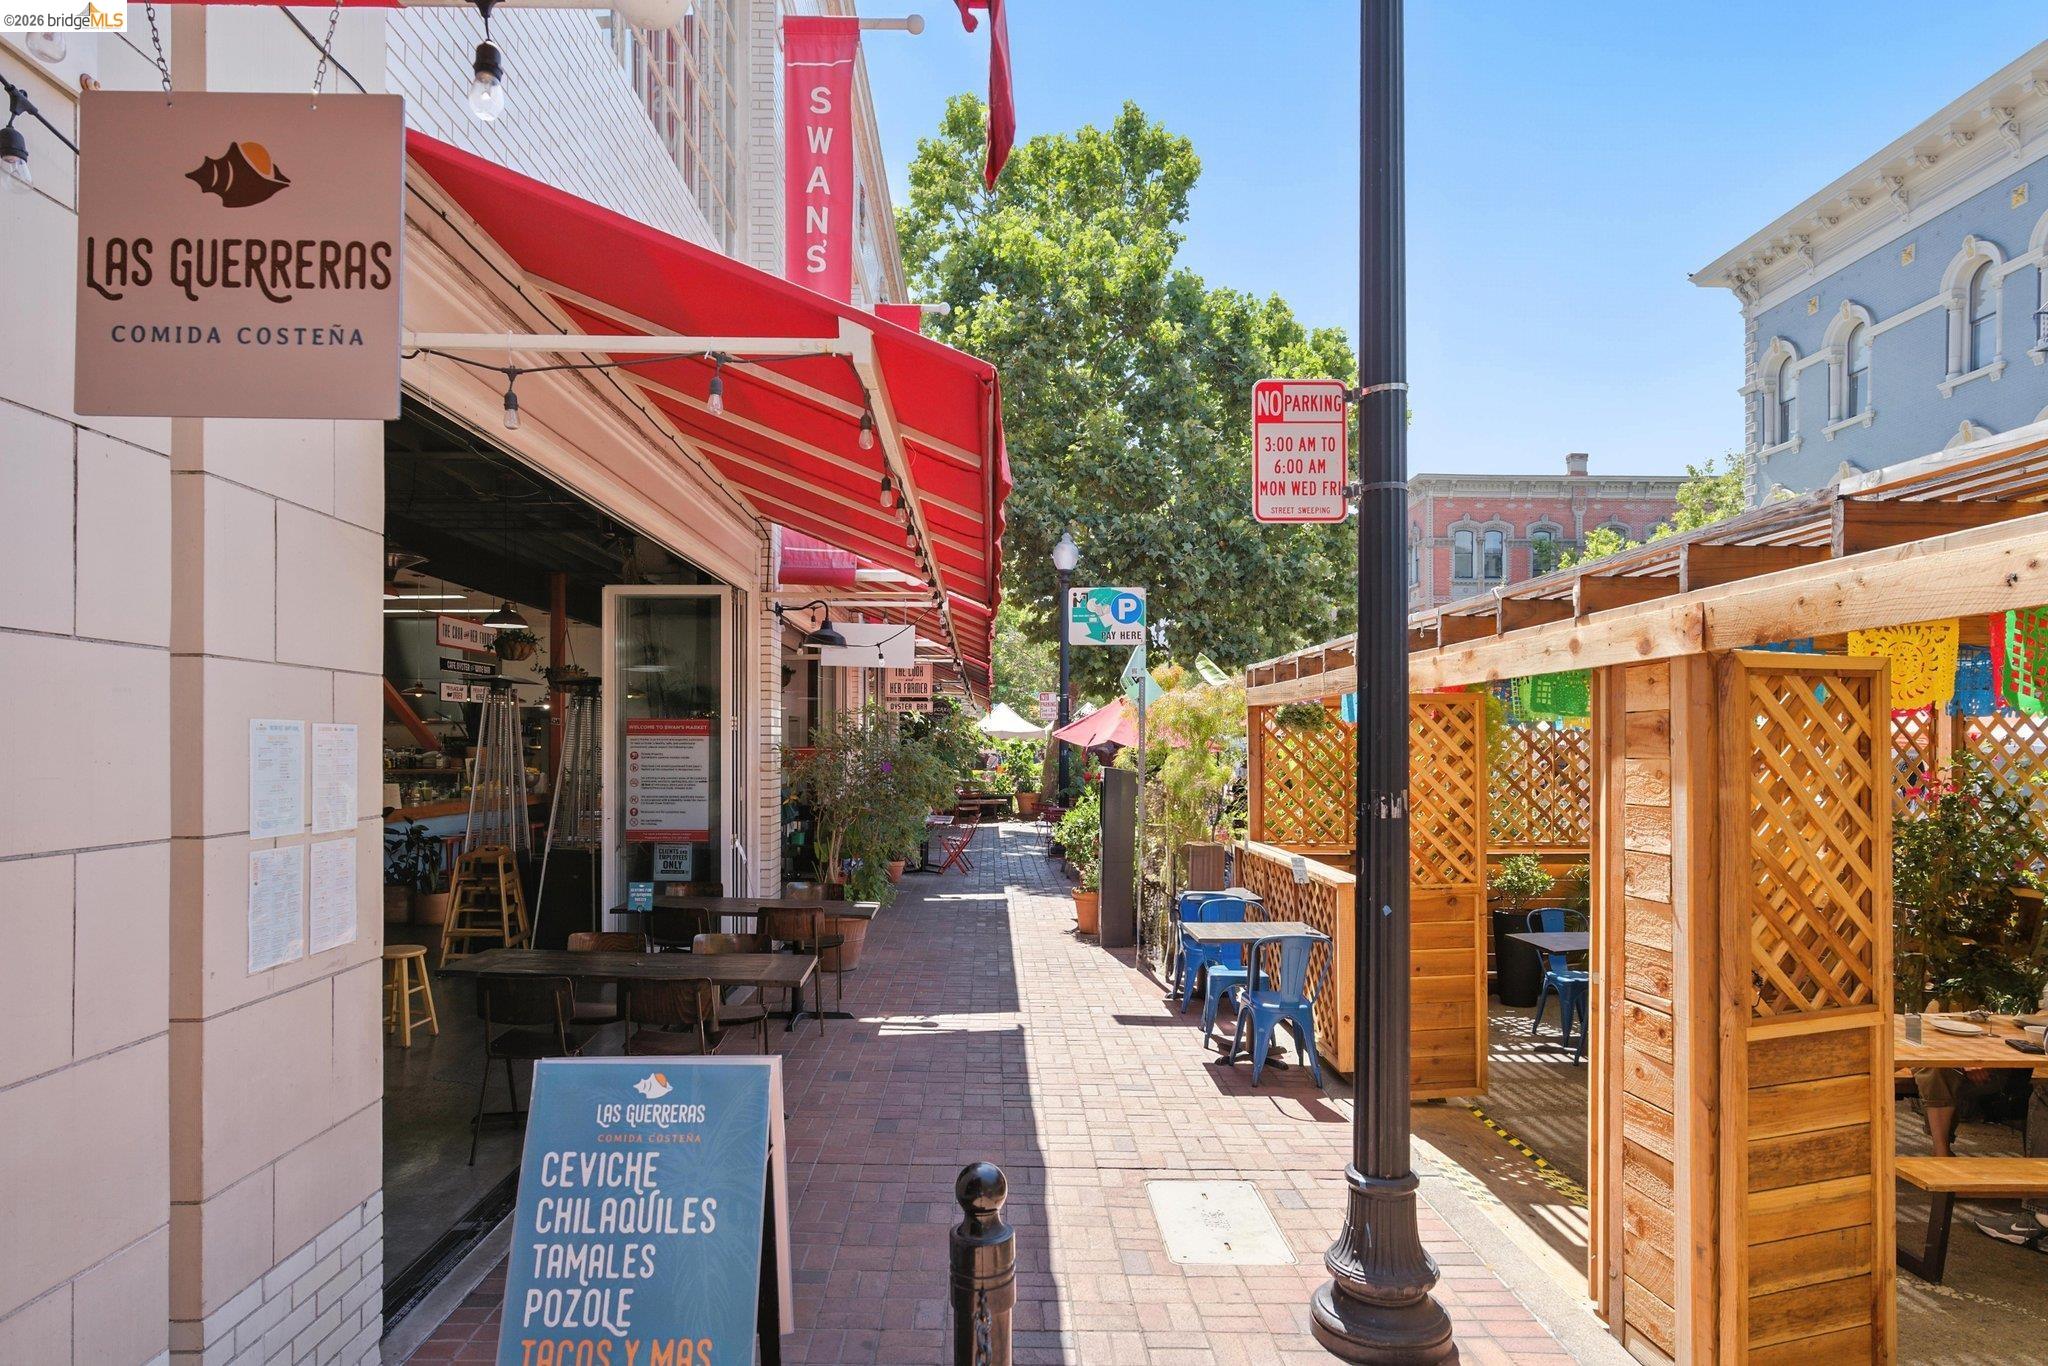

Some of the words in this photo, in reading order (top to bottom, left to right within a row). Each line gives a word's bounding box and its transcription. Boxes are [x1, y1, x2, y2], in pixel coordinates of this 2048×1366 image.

[805, 86, 833, 273] SWAN'S
[86, 236, 153, 301] LAS
[170, 237, 392, 304] GUERRERAS
[112, 325, 221, 344] COMIDA
[237, 324, 364, 346] COSTEÑA
[1257, 390, 1282, 416] NO
[1284, 394, 1341, 412] PARKING
[1264, 436, 1293, 452] 3:00
[1298, 436, 1316, 452] AM
[1321, 436, 1336, 452] TO
[1274, 458, 1303, 474] 6:00
[1308, 458, 1326, 474] AM
[1260, 481, 1286, 496] MON
[1291, 481, 1317, 496] WED
[1322, 481, 1341, 496] FRI
[1270, 506, 1294, 514] STREET
[1298, 506, 1331, 514] SWEEPING
[1118, 598, 1138, 620] P
[442, 623, 451, 638] THE
[1101, 630, 1116, 640] PAY
[1120, 630, 1142, 640] HERE
[890, 682, 902, 694] HER
[904, 682, 928, 694] FARMER
[662, 860, 683, 870] ONLY
[596, 1103, 621, 1129] LAS
[626, 1104, 706, 1129] GUERRERAS
[597, 1134, 643, 1143] COMIDA
[648, 1132, 702, 1143] COSTEÑA
[540, 1151, 661, 1195] CEVICHE
[535, 1189, 718, 1234] CHILAQUILES
[532, 1243, 657, 1287] TAMALES
[523, 1288, 635, 1338] POZOLE
[520, 1338, 613, 1366] TACOS
[624, 1337, 641, 1366] Y
[651, 1337, 714, 1366] MAS
